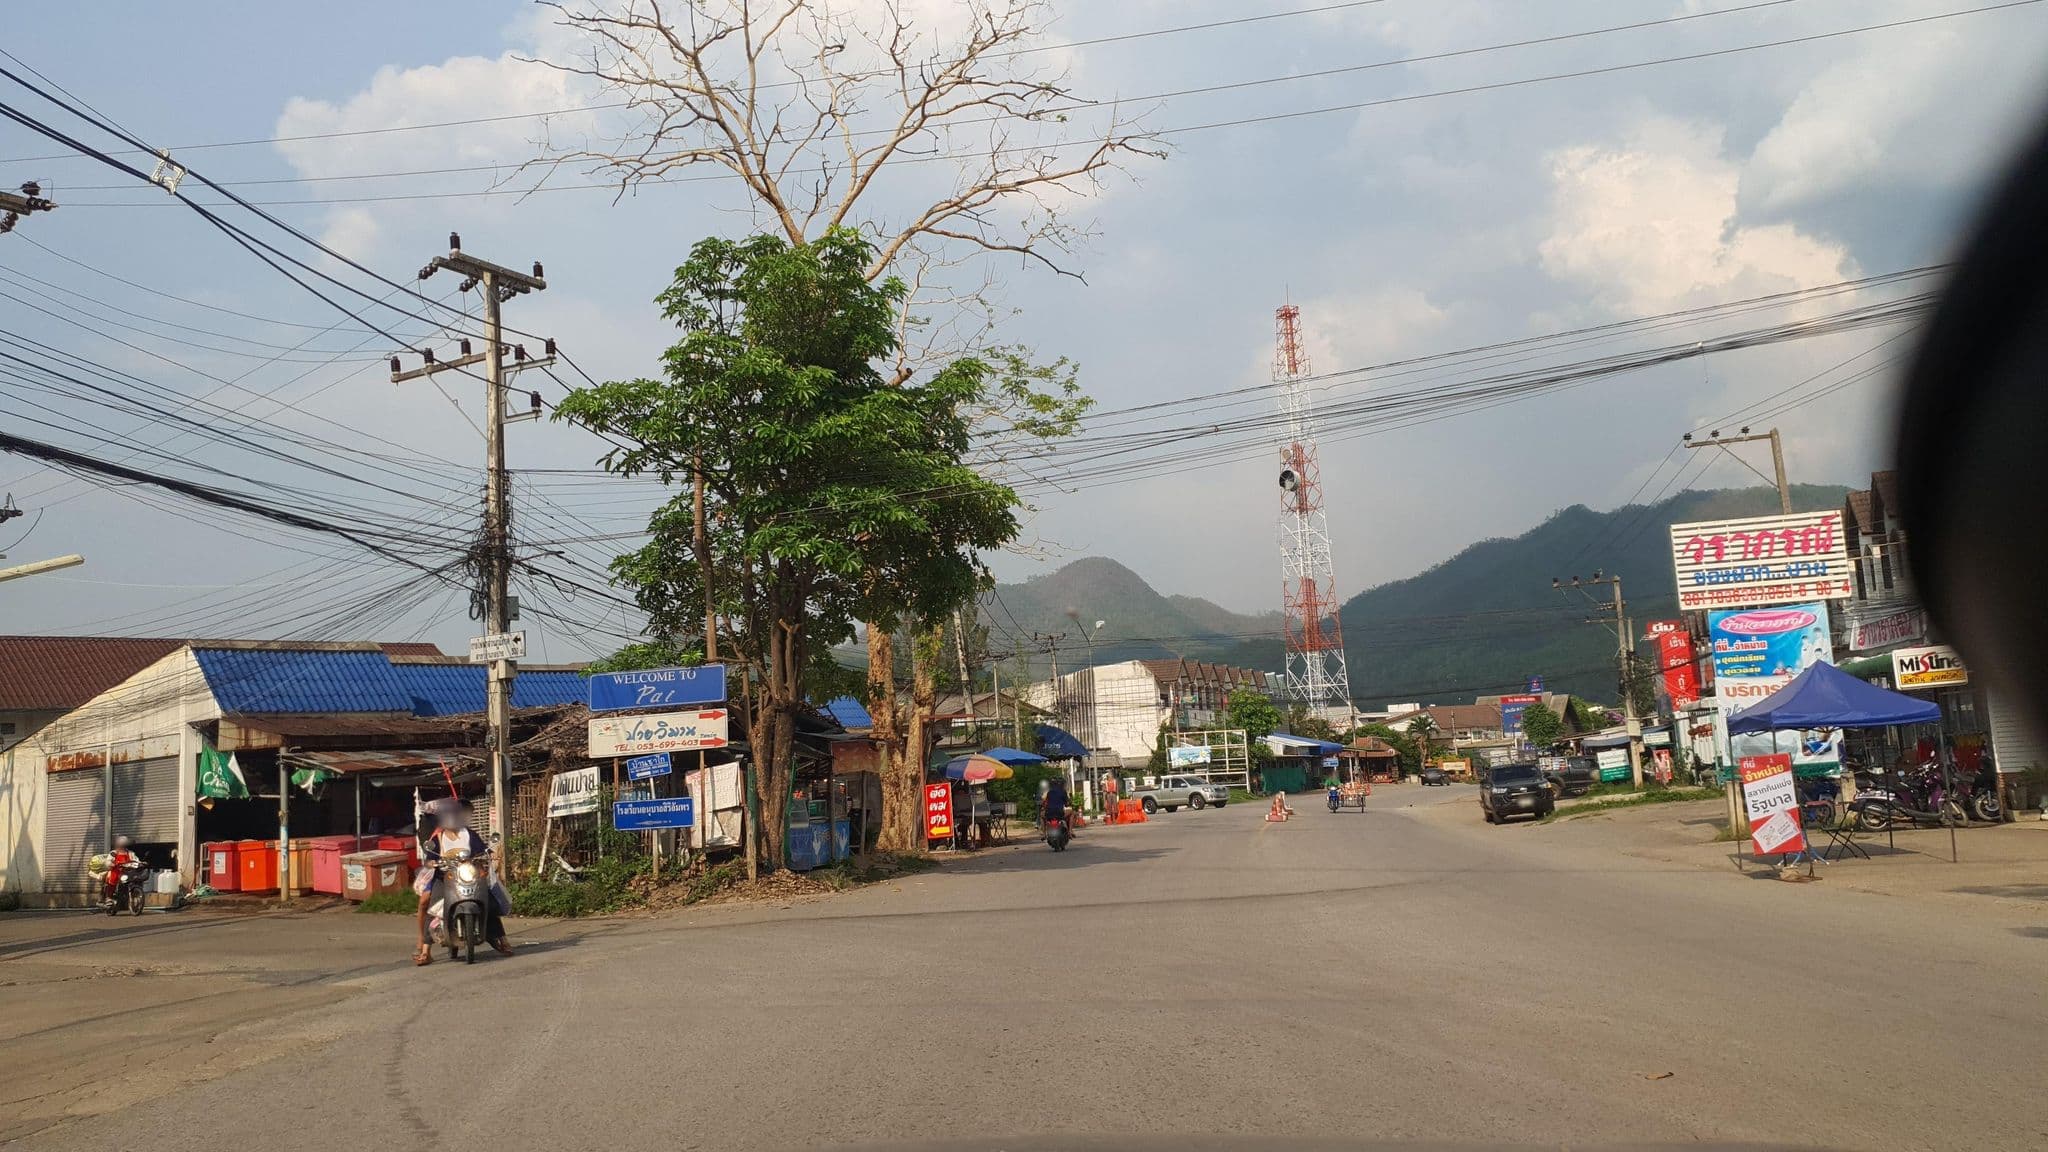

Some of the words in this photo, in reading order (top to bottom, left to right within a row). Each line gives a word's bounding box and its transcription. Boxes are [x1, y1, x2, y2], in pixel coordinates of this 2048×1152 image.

[1682, 512, 1840, 564] วราภรณ์
[613, 671, 676, 685] WELCOME
[680, 670, 697, 680] TO
[636, 684, 676, 705] Pai
[626, 720, 697, 741] ปายวิมาน
[1744, 764, 1785, 782] จำหน่าย
[1747, 779, 1792, 798] สลากกินแบ่ง
[1751, 793, 1793, 814] รัฐบาล
